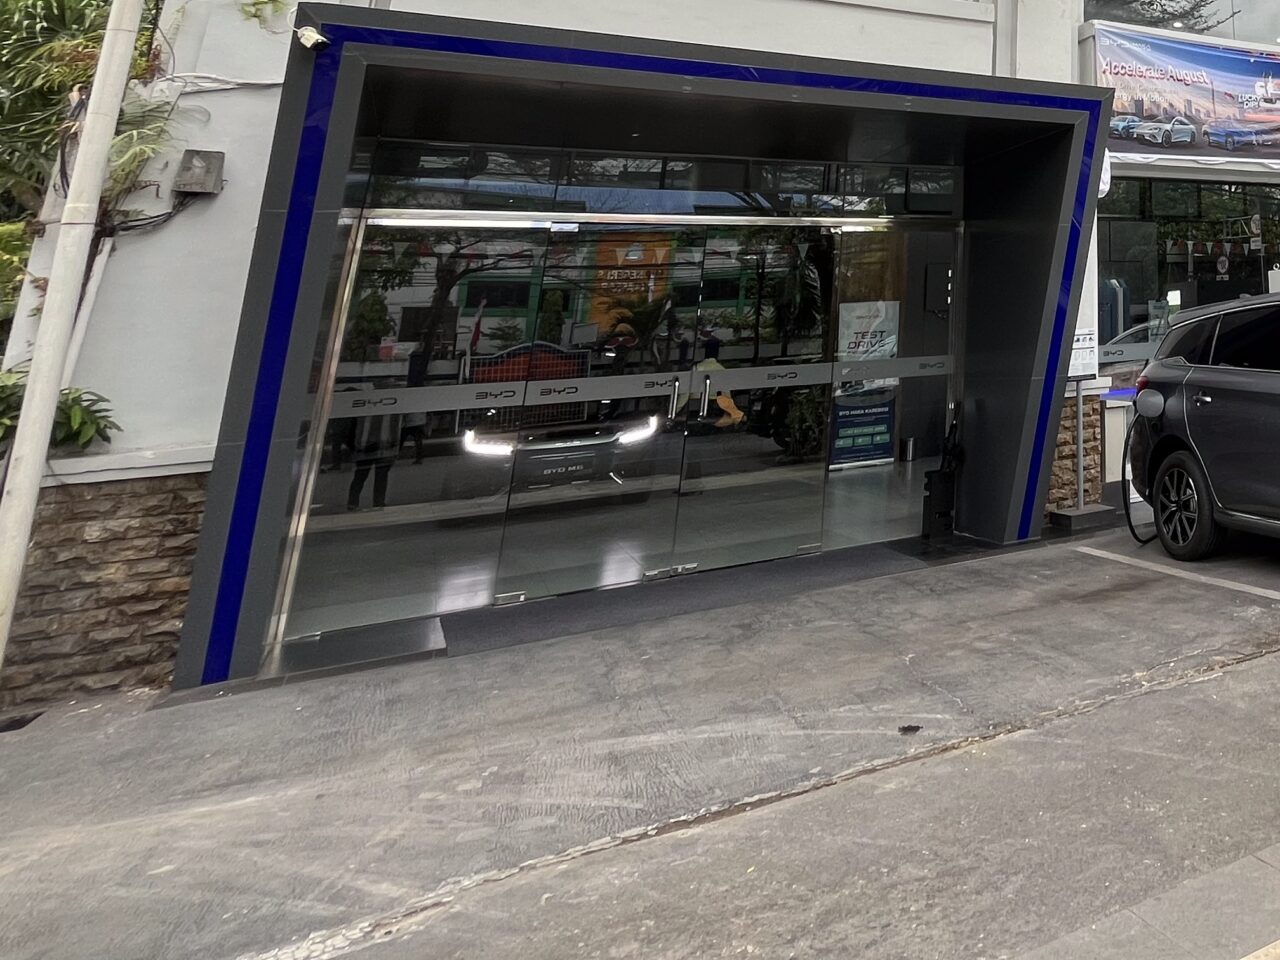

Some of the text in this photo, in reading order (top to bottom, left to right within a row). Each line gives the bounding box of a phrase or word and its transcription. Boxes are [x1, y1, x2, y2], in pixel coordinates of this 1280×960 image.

[1102, 57, 1209, 86] Accelerate August
[853, 330, 886, 341] TEST
[847, 339, 886, 350] DRIVE
[767, 371, 798, 381] BYD
[475, 390, 516, 400] BYD
[540, 386, 579, 397] BYD
[352, 397, 398, 408] BYD
[543, 467, 566, 475] BYD
